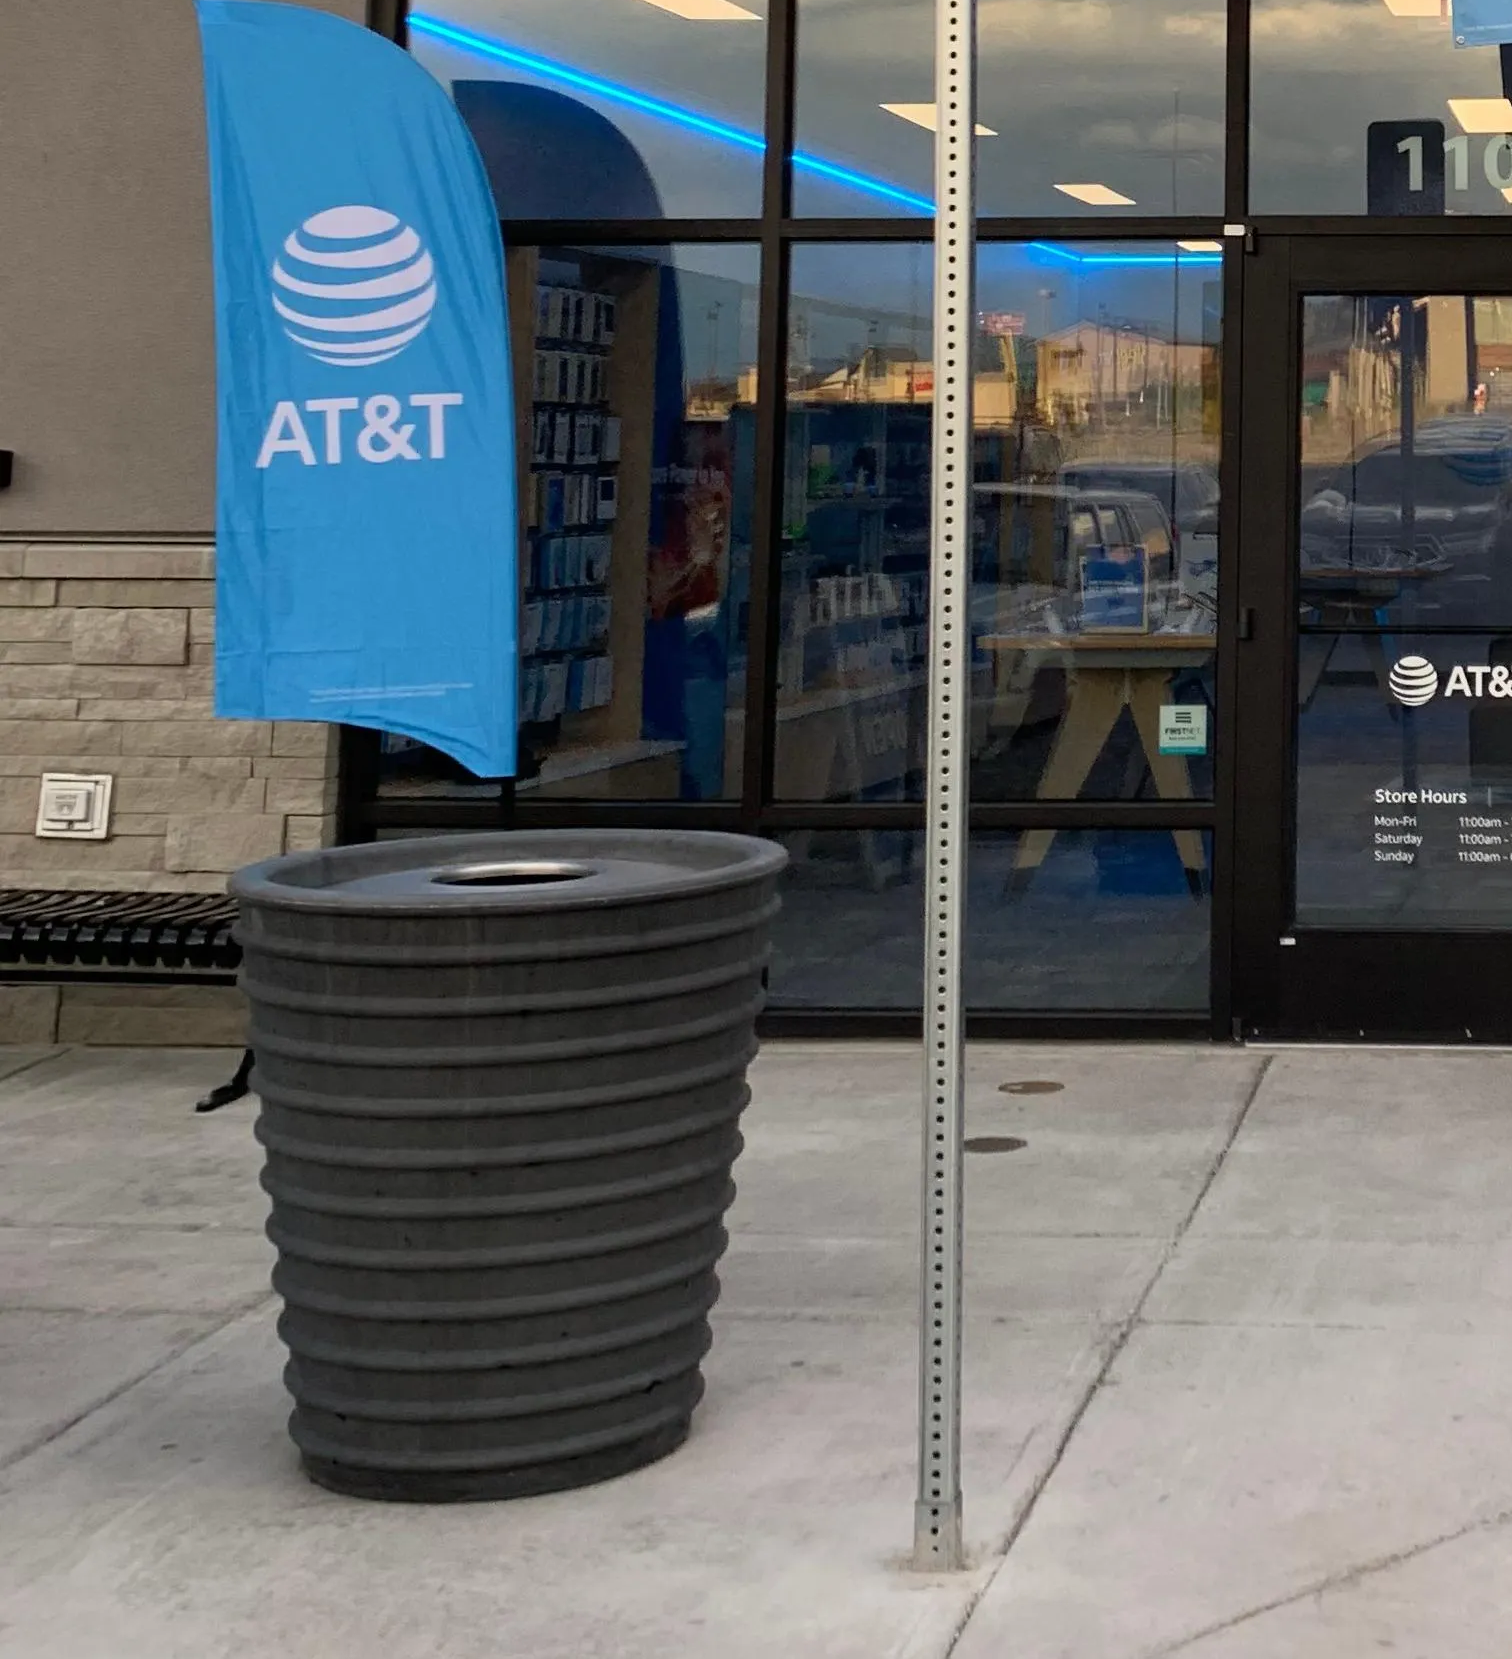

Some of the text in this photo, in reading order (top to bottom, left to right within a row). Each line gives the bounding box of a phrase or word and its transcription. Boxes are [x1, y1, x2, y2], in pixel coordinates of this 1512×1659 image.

[255, 392, 463, 468] AT&T
[1375, 788, 1468, 804] Store Hours
[1374, 815, 1417, 827] Mon-Fri
[1458, 816, 1502, 828] 11:00am
[1374, 832, 1423, 847] Saturday
[1458, 833, 1502, 845] 11:00am
[1374, 849, 1415, 864] Sunday
[1458, 850, 1501, 862] 11:00am
